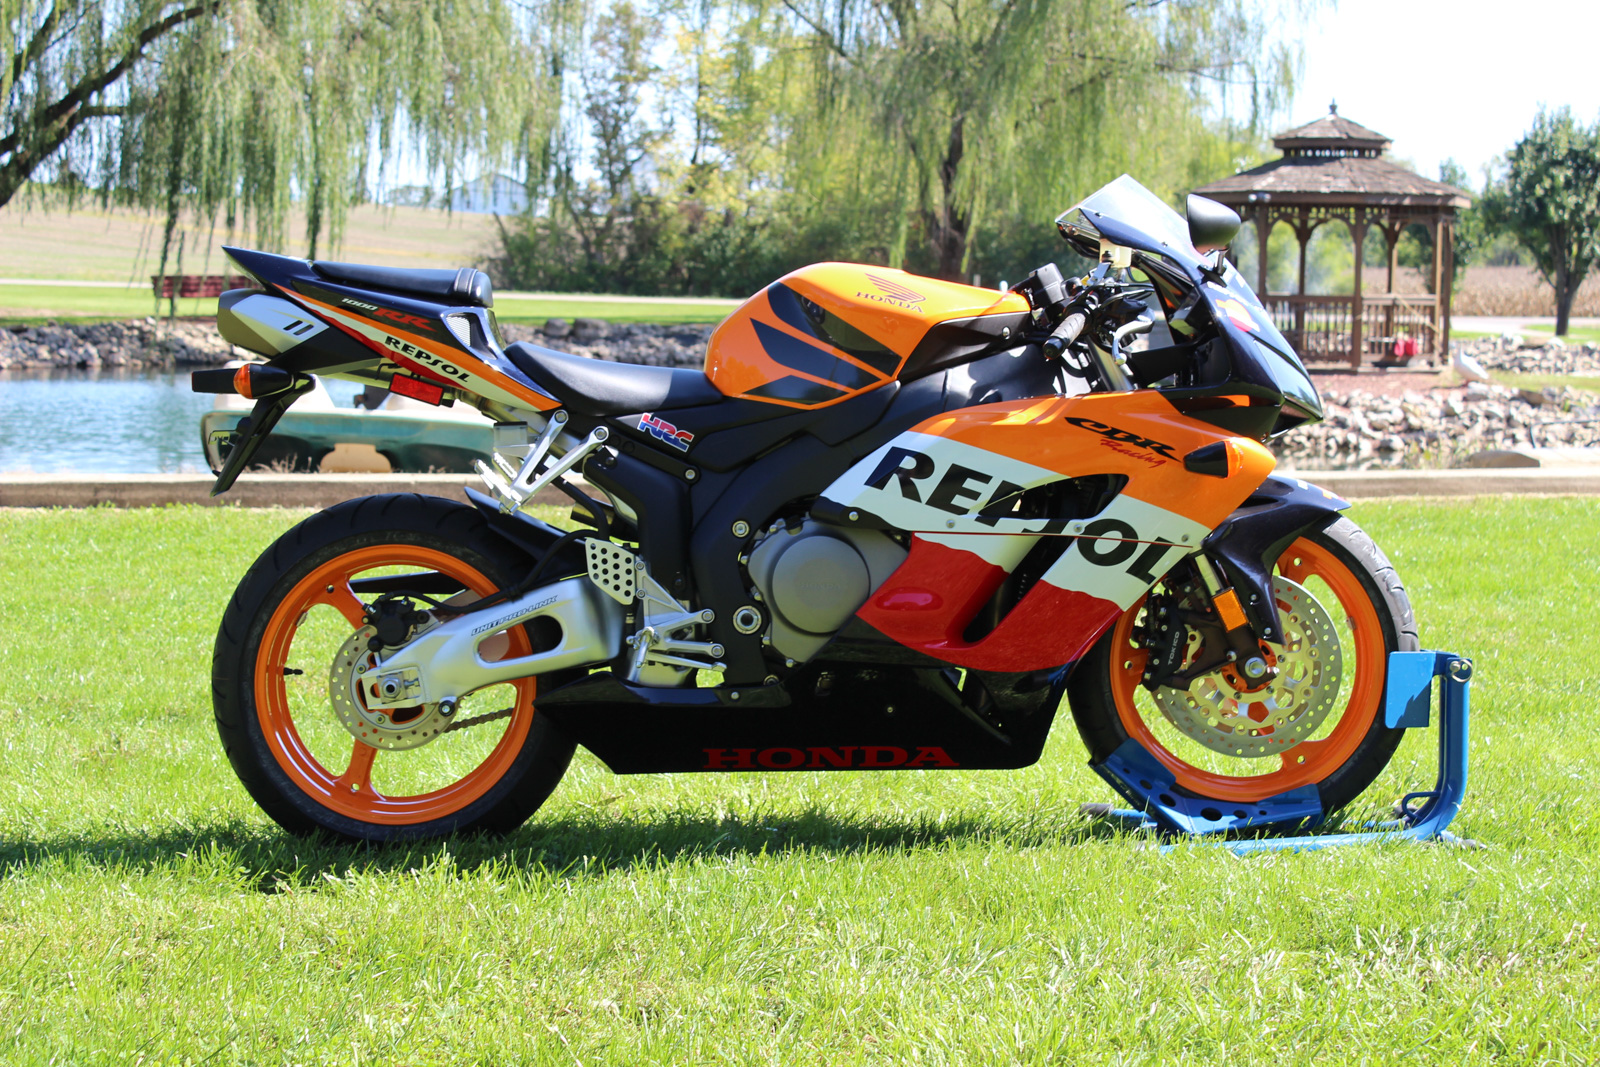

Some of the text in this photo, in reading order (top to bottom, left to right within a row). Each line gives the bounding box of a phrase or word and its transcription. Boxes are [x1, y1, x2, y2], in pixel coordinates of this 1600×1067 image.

[341, 298, 438, 332] 1000 RR
[856, 291, 924, 314] HONDA
[384, 336, 471, 383] REPSOL
[637, 412, 694, 453] HRC
[1064, 416, 1182, 463] CBR
[1100, 438, 1167, 469] Racing
[864, 446, 1175, 585] REOL
[471, 595, 558, 636] UNIT PRO-LINK
[1168, 631, 1180, 666] TOKICO
[702, 746, 960, 769] HONDA
